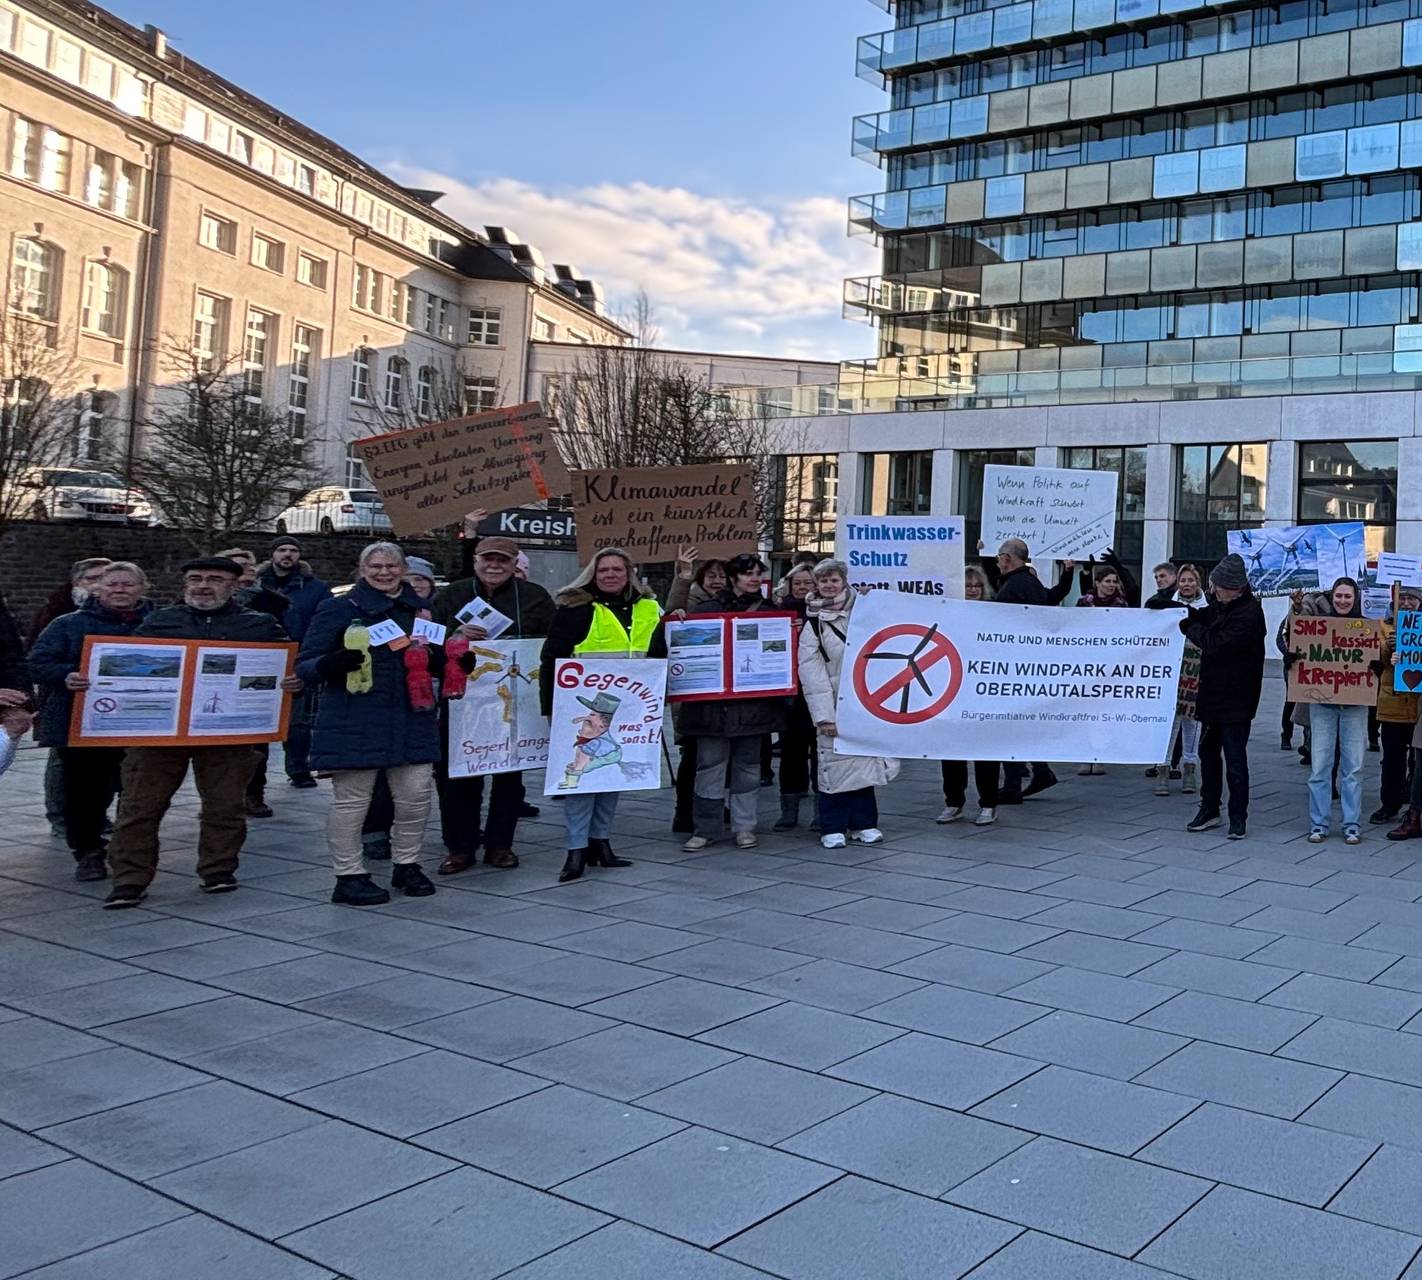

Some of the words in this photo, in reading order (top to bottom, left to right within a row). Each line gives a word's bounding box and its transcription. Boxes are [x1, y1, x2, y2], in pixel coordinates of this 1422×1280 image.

[997, 476, 1025, 489] Wenn
[1032, 476, 1063, 490] Politik
[1070, 479, 1091, 493] auf
[996, 495, 1045, 508] Windkraft
[591, 509, 614, 527] ist
[626, 508, 655, 523] ein
[663, 500, 748, 521] künstlich
[996, 514, 1016, 523] wird
[1021, 515, 1035, 524] die
[1044, 514, 1078, 526] Umwelt
[593, 527, 692, 556] geschaffenes
[695, 523, 753, 545] Problem
[846, 524, 961, 541] Trinkwasser-
[849, 550, 908, 567] Schutz
[897, 580, 944, 596] WEAs
[1293, 620, 1328, 636] SMS
[976, 632, 1015, 644] NATUR
[1018, 634, 1042, 645] UND
[1046, 636, 1108, 646] MENSCHEN
[1111, 635, 1170, 647] SCHÜTZEN!
[1309, 643, 1364, 663] NATUR
[967, 660, 1009, 676] KEIN
[1015, 662, 1107, 677] WINDPARK
[1110, 664, 1134, 678] AN
[1140, 665, 1172, 679] DER
[557, 661, 662, 724] Gegenwind
[975, 681, 1162, 700] OBERNAUTALSPERRE!
[961, 710, 1036, 723] Bürgerinitiative
[1039, 711, 1099, 722] Windkraftfrei
[1101, 713, 1168, 723] Si-Wi-Obernau
[618, 723, 643, 733] was
[619, 726, 663, 745] sonst!
